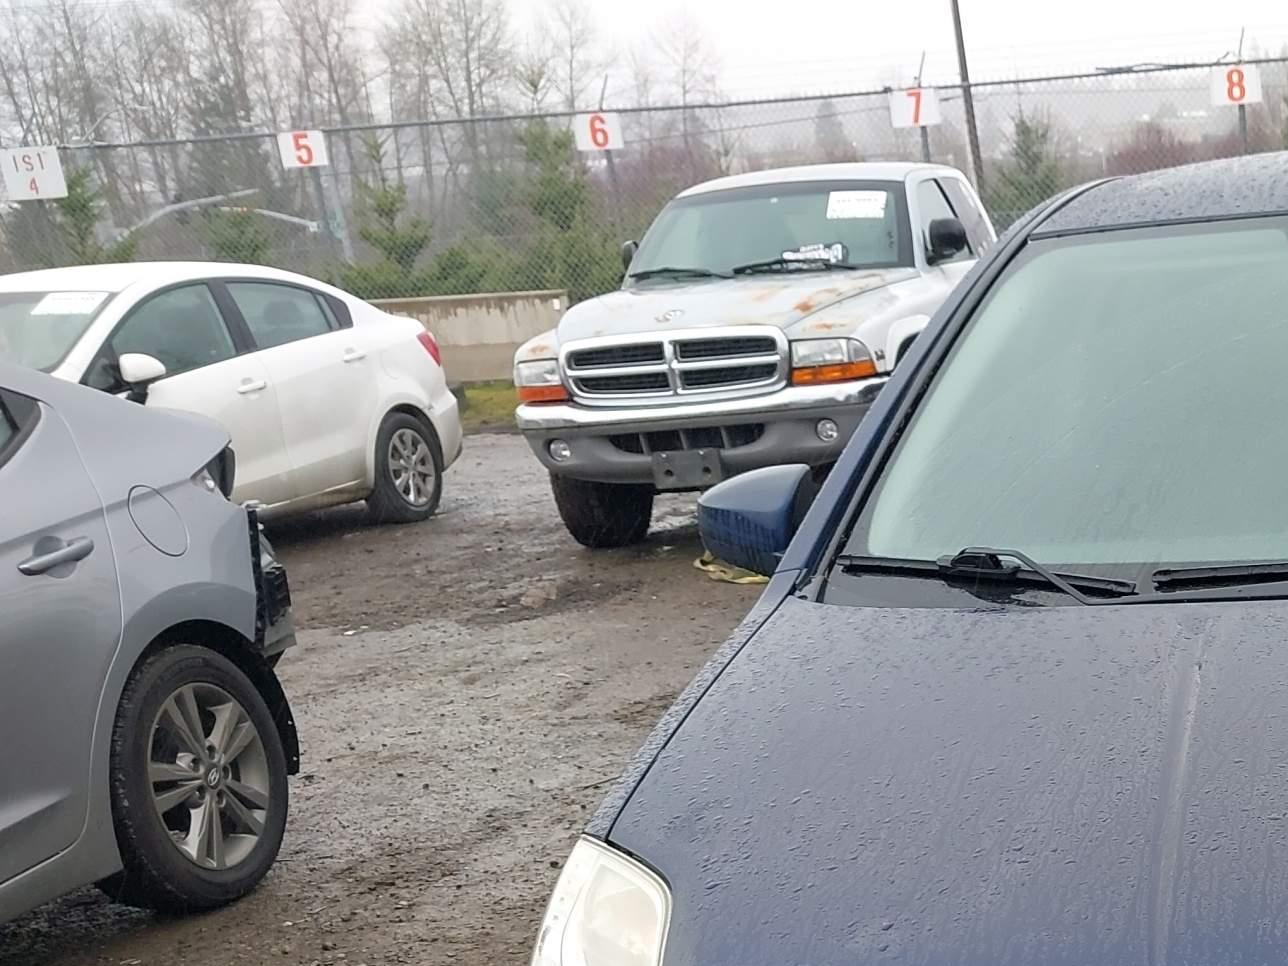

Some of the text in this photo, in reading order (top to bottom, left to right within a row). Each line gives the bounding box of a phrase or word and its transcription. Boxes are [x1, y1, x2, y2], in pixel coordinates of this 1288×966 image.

[1226, 69, 1246, 102] 8
[906, 91, 922, 124] 7
[589, 114, 609, 148] 6
[292, 132, 314, 165] 5
[29, 176, 40, 195] 4
